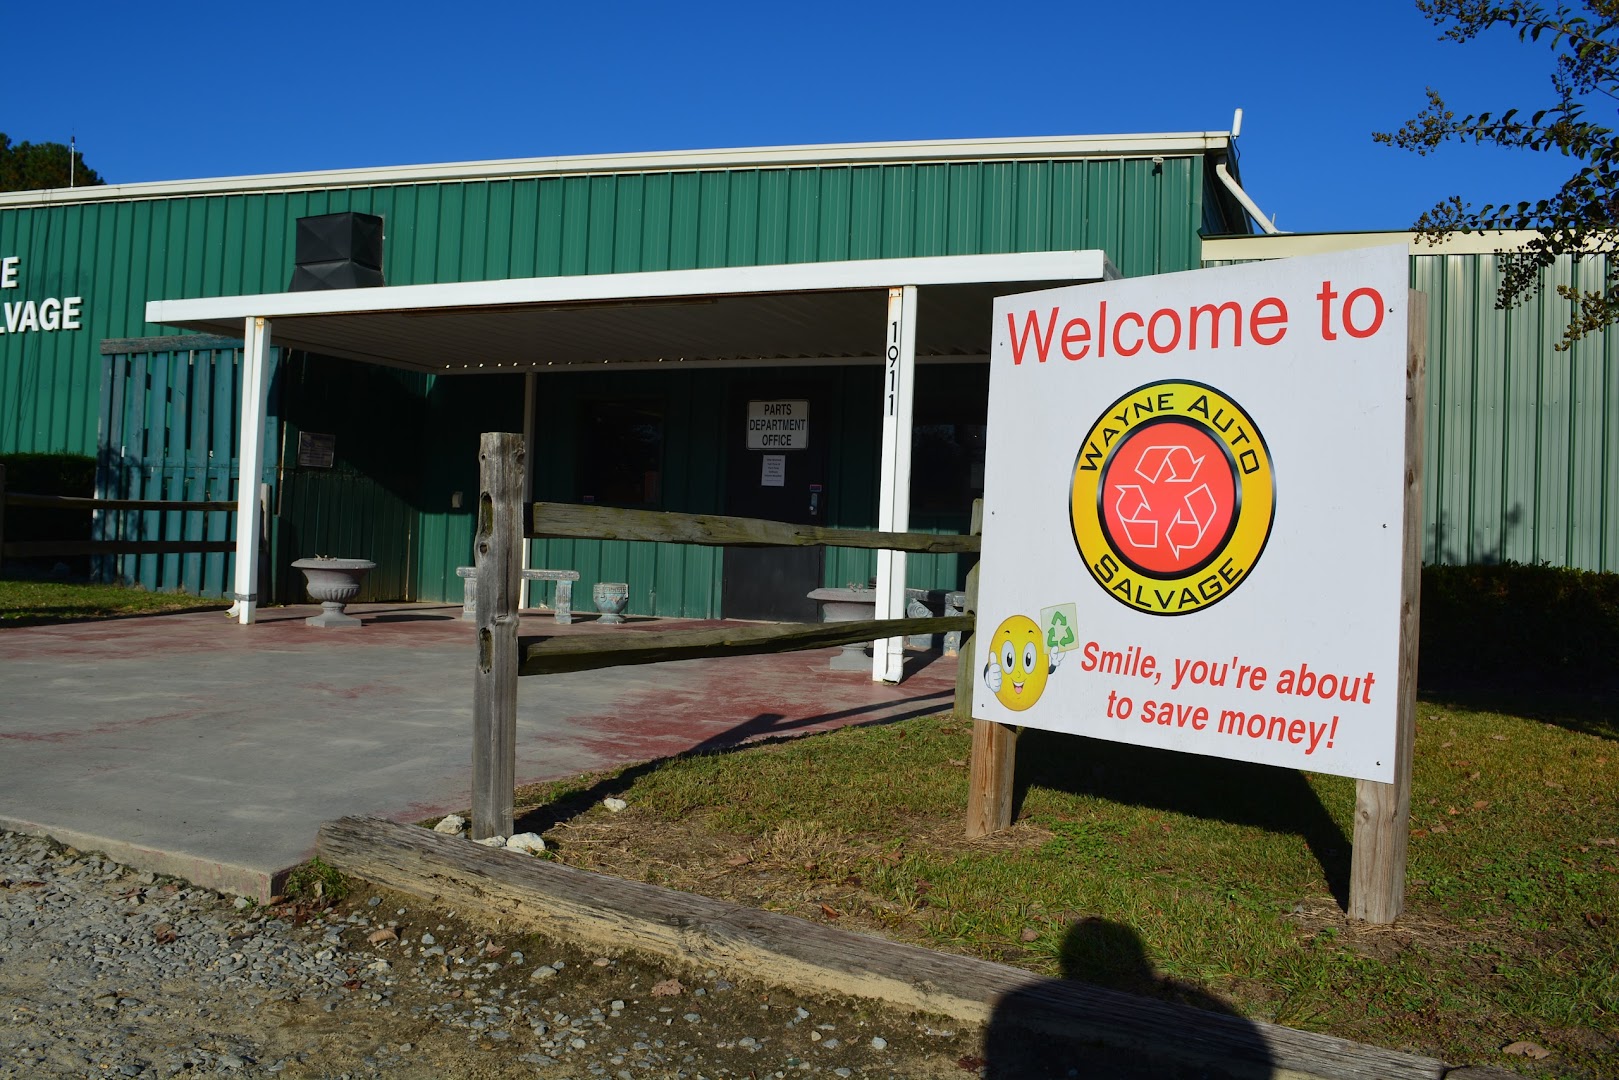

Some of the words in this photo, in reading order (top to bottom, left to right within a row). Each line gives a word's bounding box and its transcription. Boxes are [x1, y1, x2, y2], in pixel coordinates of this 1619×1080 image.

[1007, 296, 1289, 366] Welcome
[1316, 280, 1385, 342] to
[887, 320, 899, 416] 1911
[749, 419, 806, 431] DEPARTMENT
[762, 434, 792, 446] OFFICE
[764, 403, 792, 416] PARTS
[1080, 393, 1174, 472] WAYNE
[1187, 394, 1260, 475] AUTO
[1093, 553, 1244, 610] SALVAGE
[1080, 641, 1162, 686] Smile,
[1170, 656, 1268, 692] you're
[1275, 663, 1376, 705] about
[1106, 690, 1133, 720] to
[1140, 699, 1209, 731] save
[1217, 709, 1340, 756] money!
